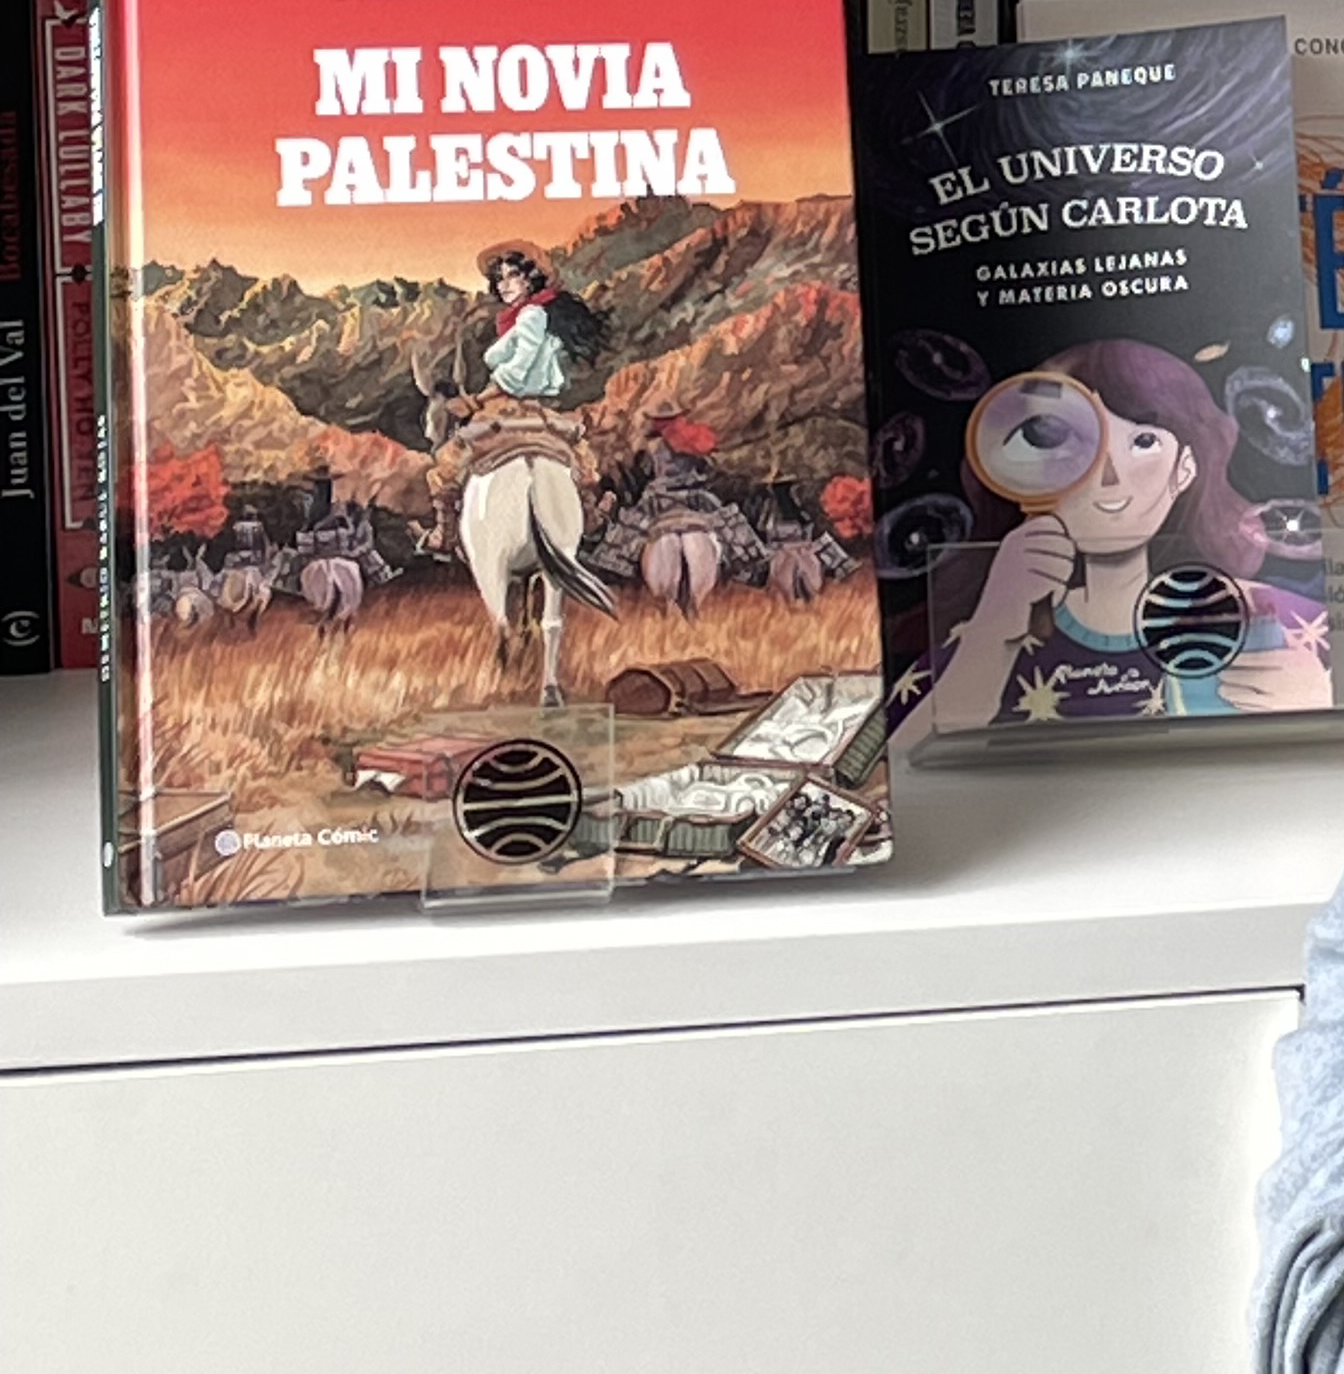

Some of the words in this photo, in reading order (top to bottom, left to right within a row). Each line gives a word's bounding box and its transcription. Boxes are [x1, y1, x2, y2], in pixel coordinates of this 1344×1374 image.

[313, 47, 424, 117] MI
[439, 41, 692, 114] NOVIA
[987, 73, 1069, 98] TERESA
[1076, 63, 1177, 89] PANEQUE
[274, 127, 738, 208] PALESTINA
[928, 166, 992, 207] EL
[996, 142, 1226, 185] UNIVERSO
[909, 201, 1050, 257] SEGÚN
[1061, 195, 1249, 231] CARLOTA
[975, 257, 1088, 282] GALAXIAS
[1094, 247, 1189, 274] LEJANAS
[976, 290, 988, 308] Y
[998, 284, 1093, 308] MATERIA
[1101, 274, 1189, 299] OSCURA
[0, 377, 28, 422] del
[2, 429, 34, 498] Juan
[243, 829, 314, 852] Planeta
[318, 823, 379, 846] Cómic
